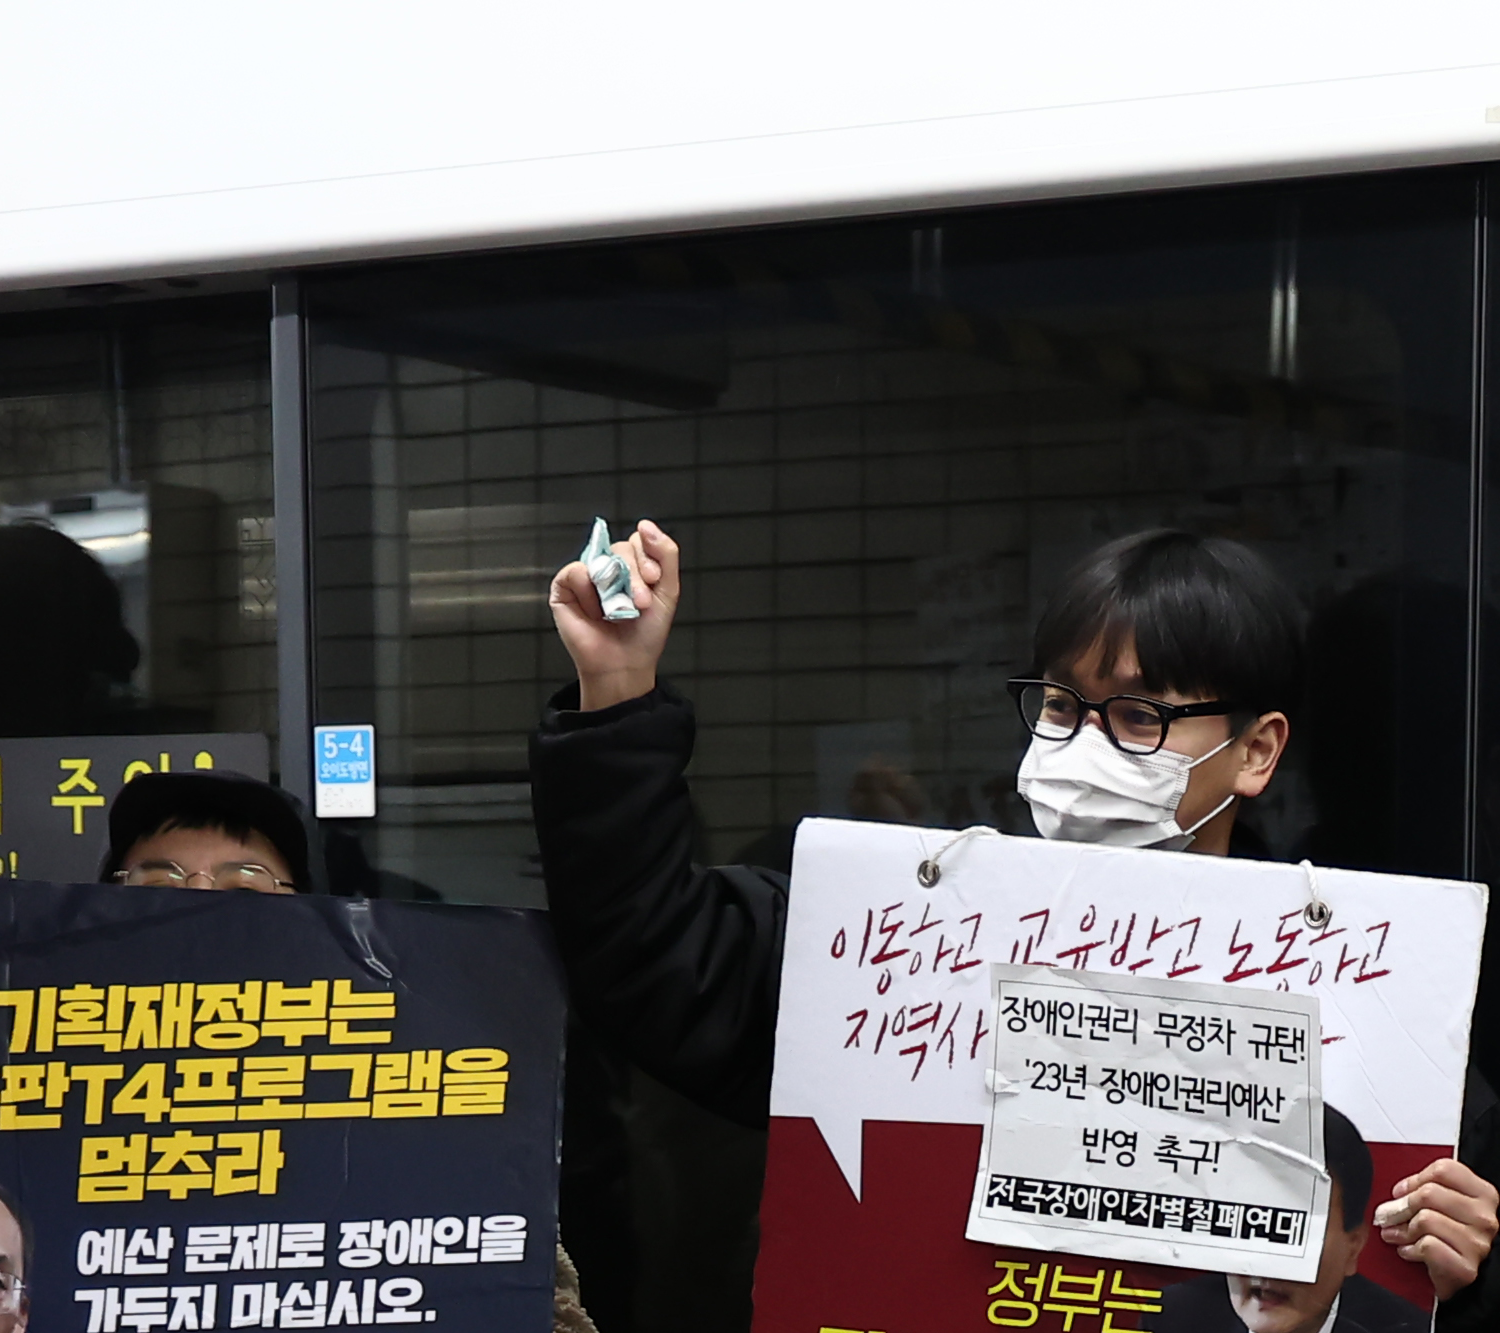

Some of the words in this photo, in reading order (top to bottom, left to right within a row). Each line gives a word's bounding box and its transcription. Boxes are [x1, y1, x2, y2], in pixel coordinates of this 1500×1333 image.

[324, 732, 364, 758] 5-4
[831, 902, 983, 995] 이동하고
[1001, 995, 1138, 1045] 장애인권리
[1153, 1010, 1236, 1057] 무정차
[1247, 1020, 1307, 1064] 규탄!
[1099, 1067, 1284, 1125] 장애인권리예산
[77, 1129, 284, 1202] 멈추라
[1081, 1127, 1139, 1170] 반영
[1155, 1134, 1220, 1175] 촉구!
[987, 1175, 1307, 1247] 전국장애인차별철폐연대
[76, 1226, 174, 1276] 예산
[184, 1222, 326, 1273] 문제로
[337, 1214, 528, 1266] 장애인을
[229, 1277, 437, 1330] 마십시오.
